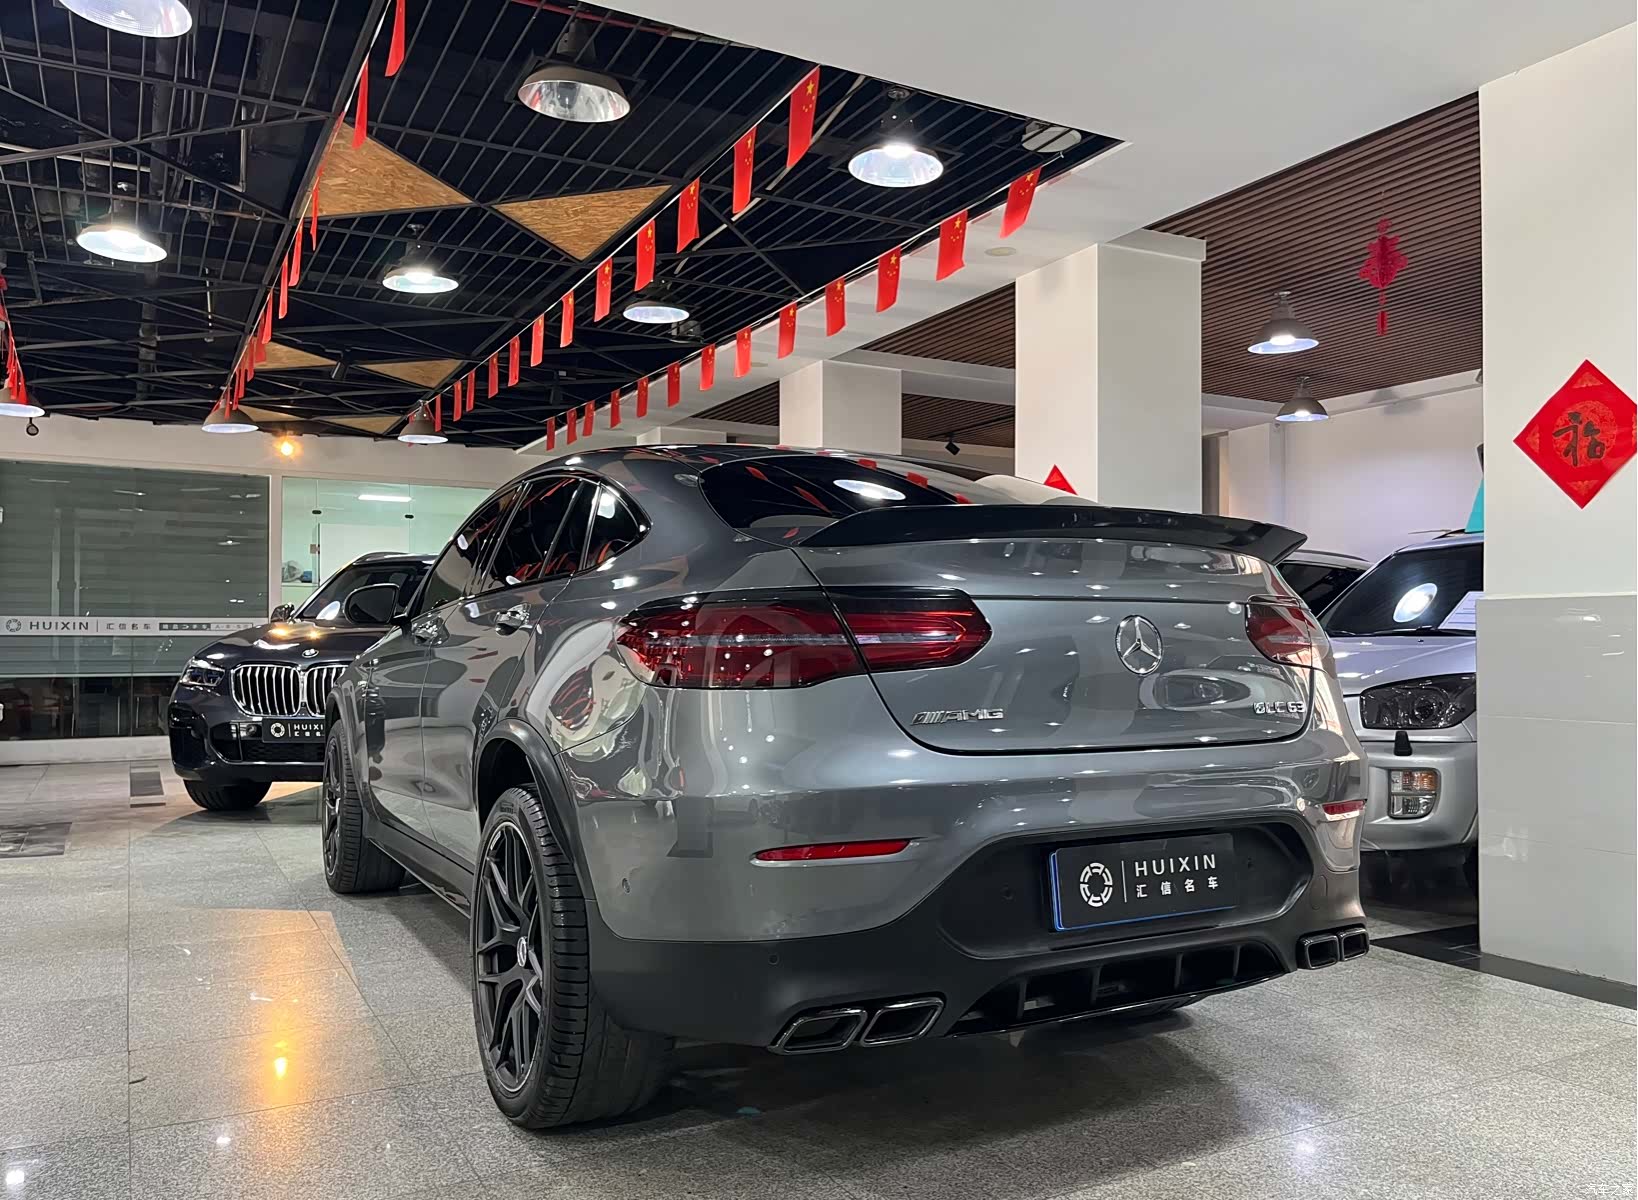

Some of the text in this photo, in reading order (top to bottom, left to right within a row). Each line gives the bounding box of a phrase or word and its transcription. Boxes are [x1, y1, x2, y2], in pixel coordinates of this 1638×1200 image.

[1552, 411, 1606, 467] 福
[29, 621, 89, 631] HUIXIN
[1286, 701, 1305, 713] 63
[938, 708, 1004, 722] AMG
[293, 723, 324, 731] HUIXI
[1134, 854, 1216, 877] HUIXIN
[1136, 875, 1219, 898] 汇信名车
